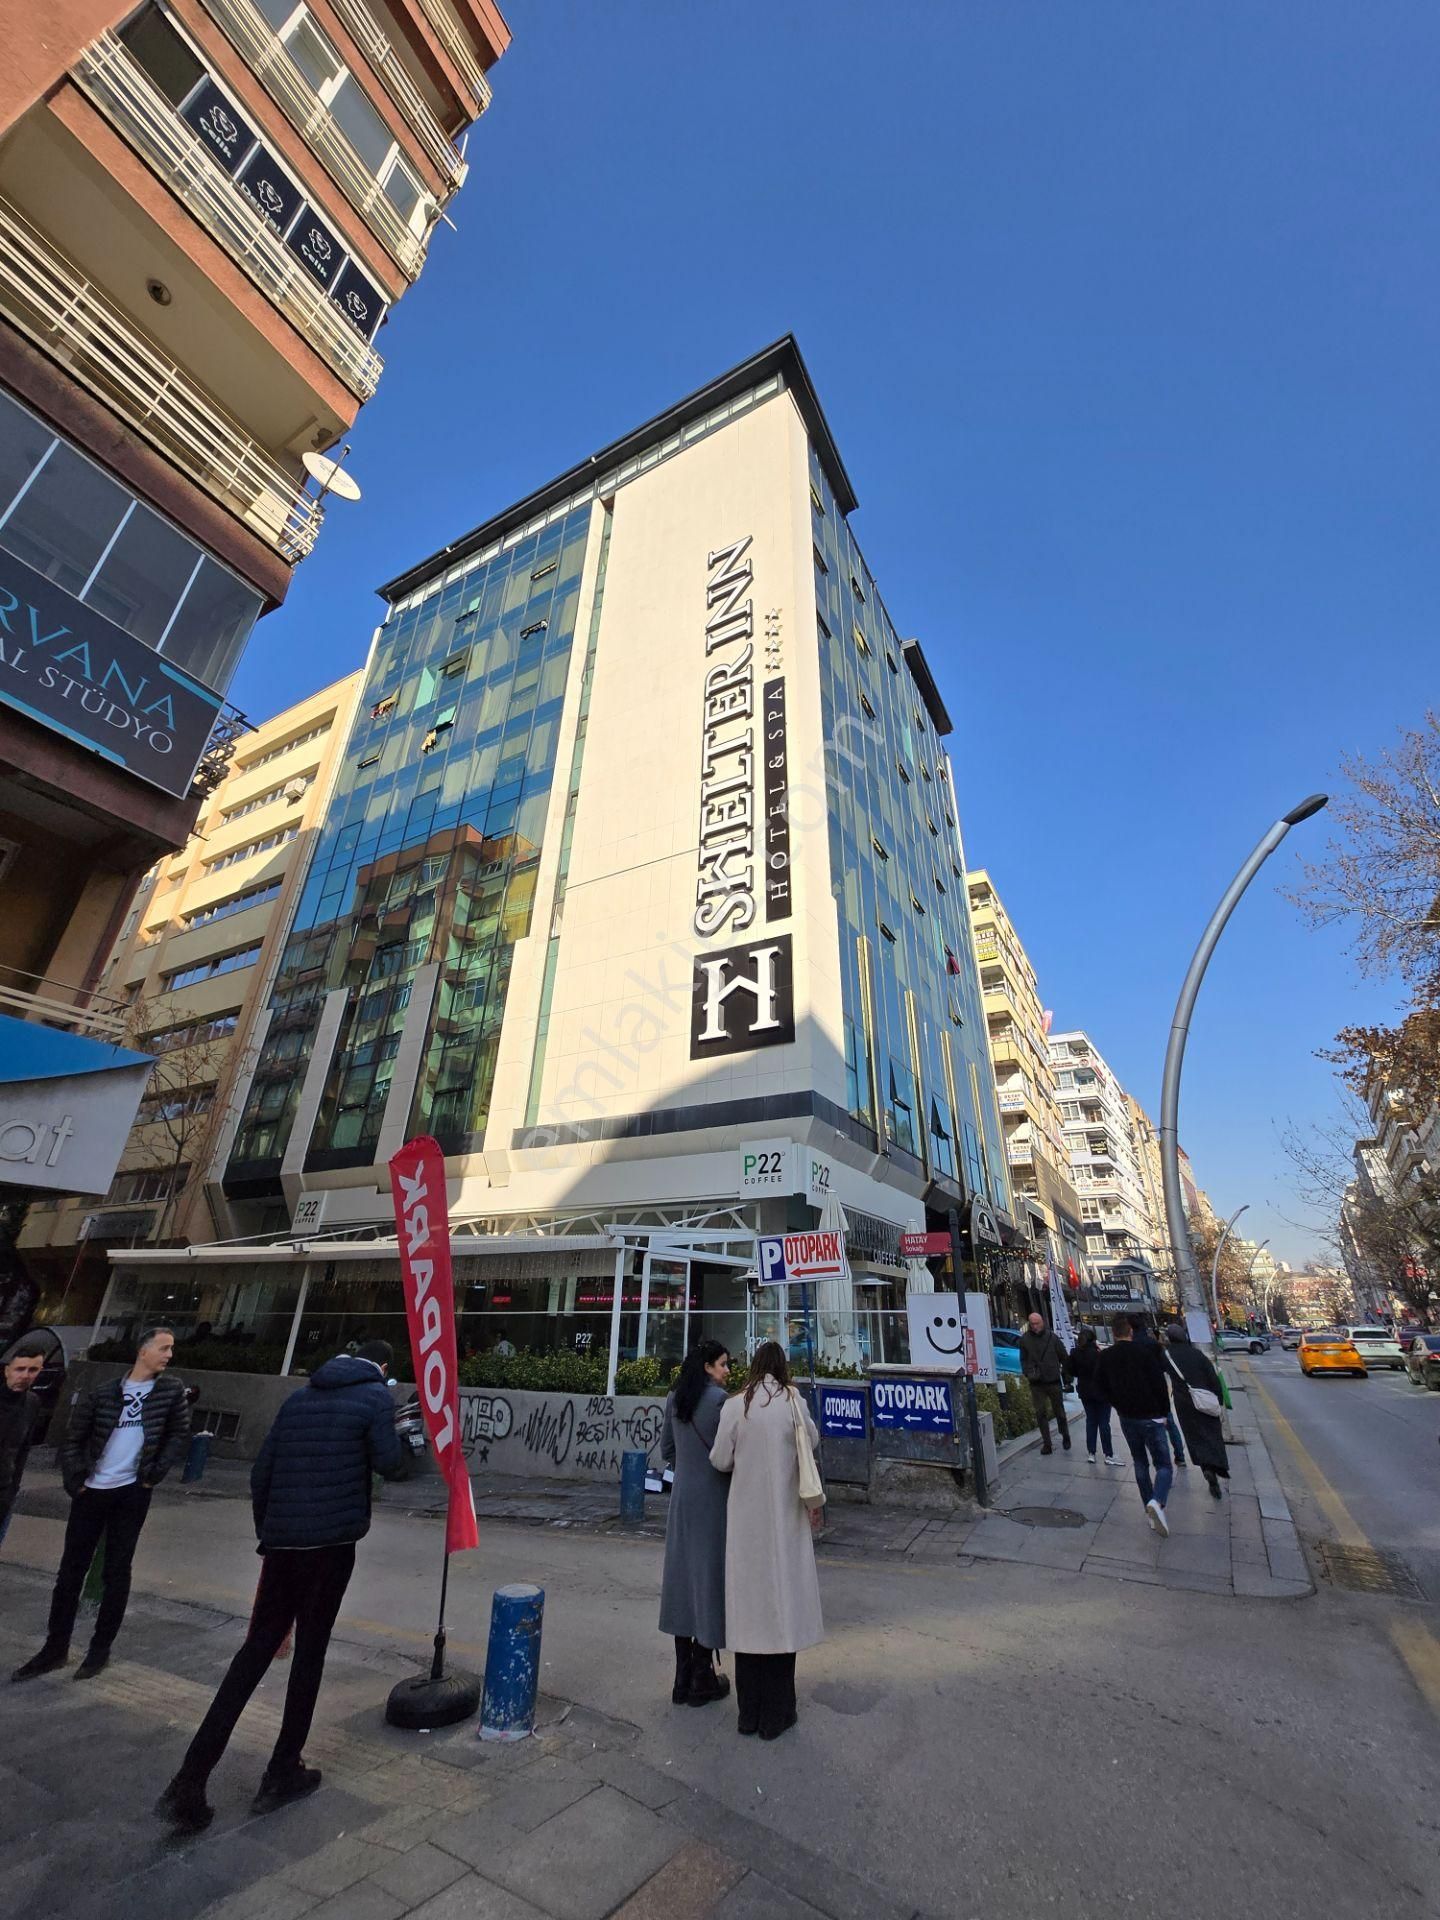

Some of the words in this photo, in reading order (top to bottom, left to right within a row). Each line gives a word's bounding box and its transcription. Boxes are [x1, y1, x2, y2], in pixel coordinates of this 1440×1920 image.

[705, 534, 754, 658] INN
[0, 586, 177, 732] RVANA
[38, 666, 174, 754] STÜDYO
[768, 686, 785, 740] SPA
[768, 751, 785, 769] &
[769, 780, 789, 901] HOTEL
[744, 1151, 782, 1176] P22
[811, 1161, 830, 1188] P22
[744, 1175, 782, 1185] COFFEE
[811, 1184, 828, 1196] COFF
[297, 1200, 319, 1217] P22
[784, 1232, 842, 1266] OTOPARK
[905, 1235, 928, 1245] HATAY
[575, 1332, 592, 1343] P22
[978, 1367, 989, 1377] 22
[586, 1396, 615, 1418] 1903
[825, 1397, 862, 1419] OTOPARK
[873, 1384, 949, 1411] OTOPARK
